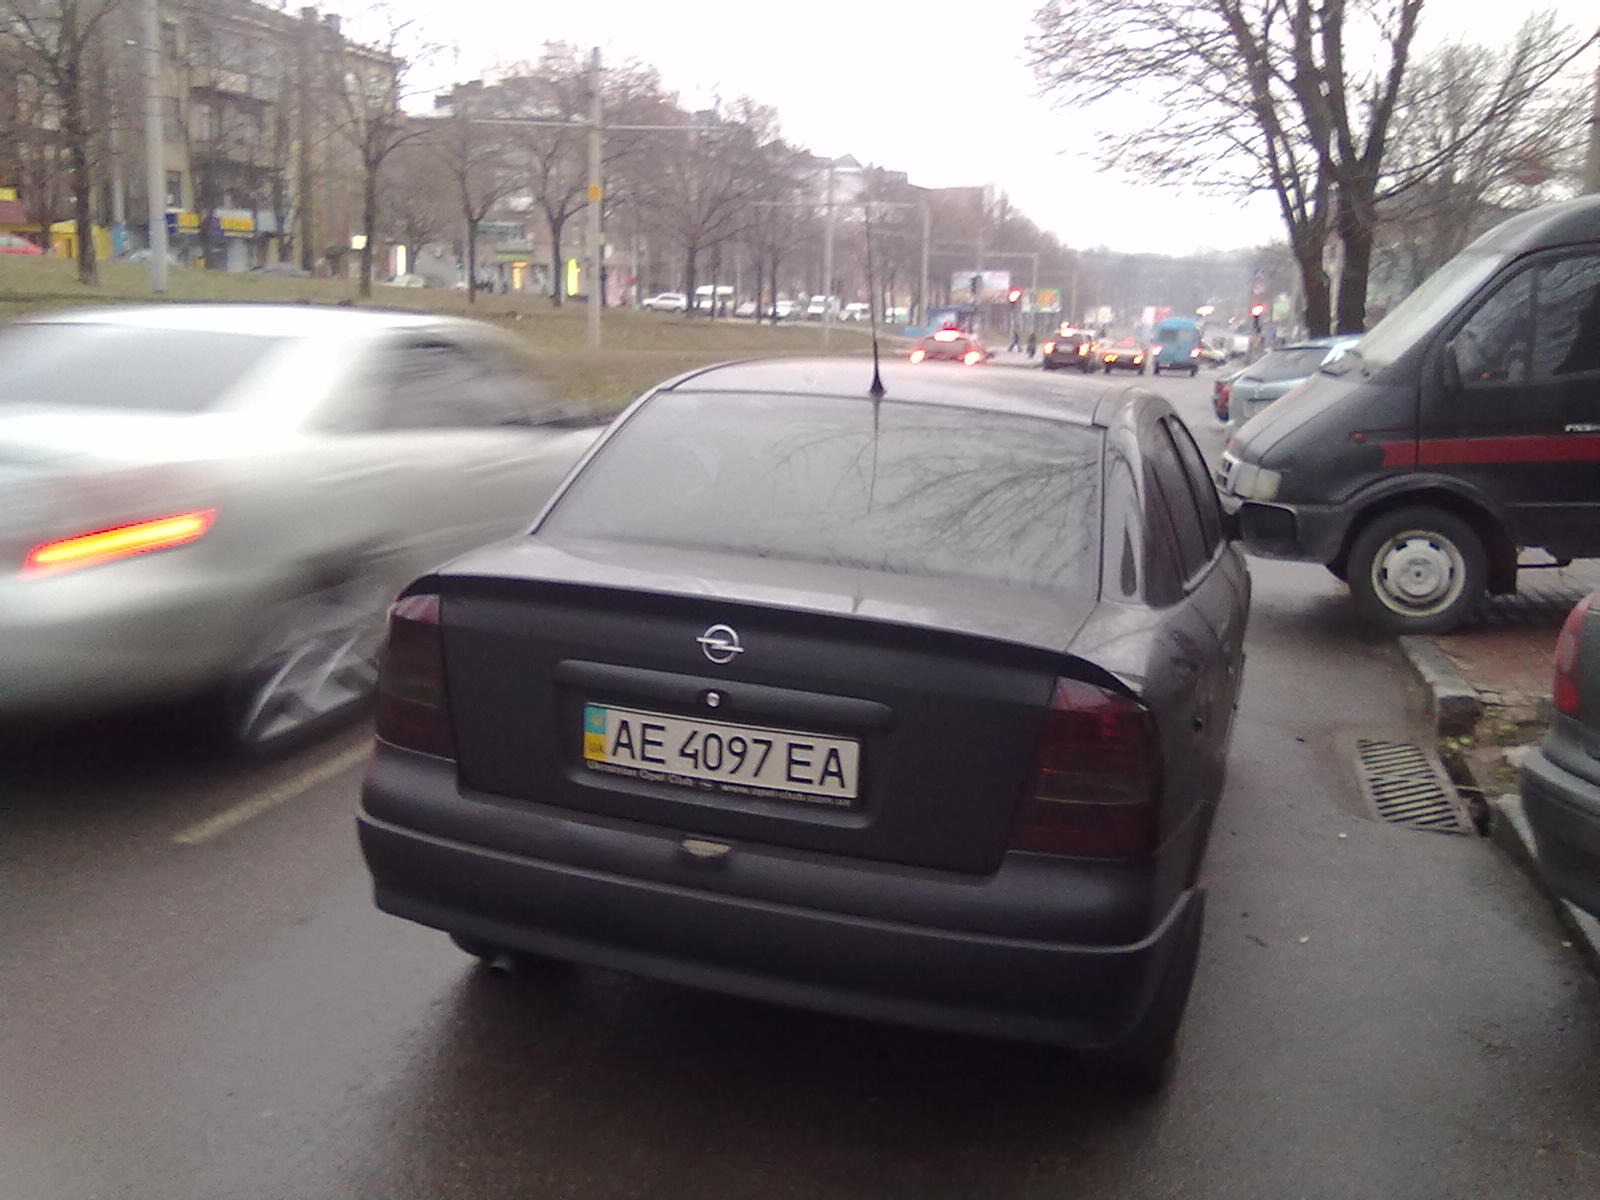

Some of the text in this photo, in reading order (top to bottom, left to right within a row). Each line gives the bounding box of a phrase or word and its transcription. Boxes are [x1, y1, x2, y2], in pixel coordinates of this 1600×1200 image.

[612, 720, 846, 788] AE 4097 EA
